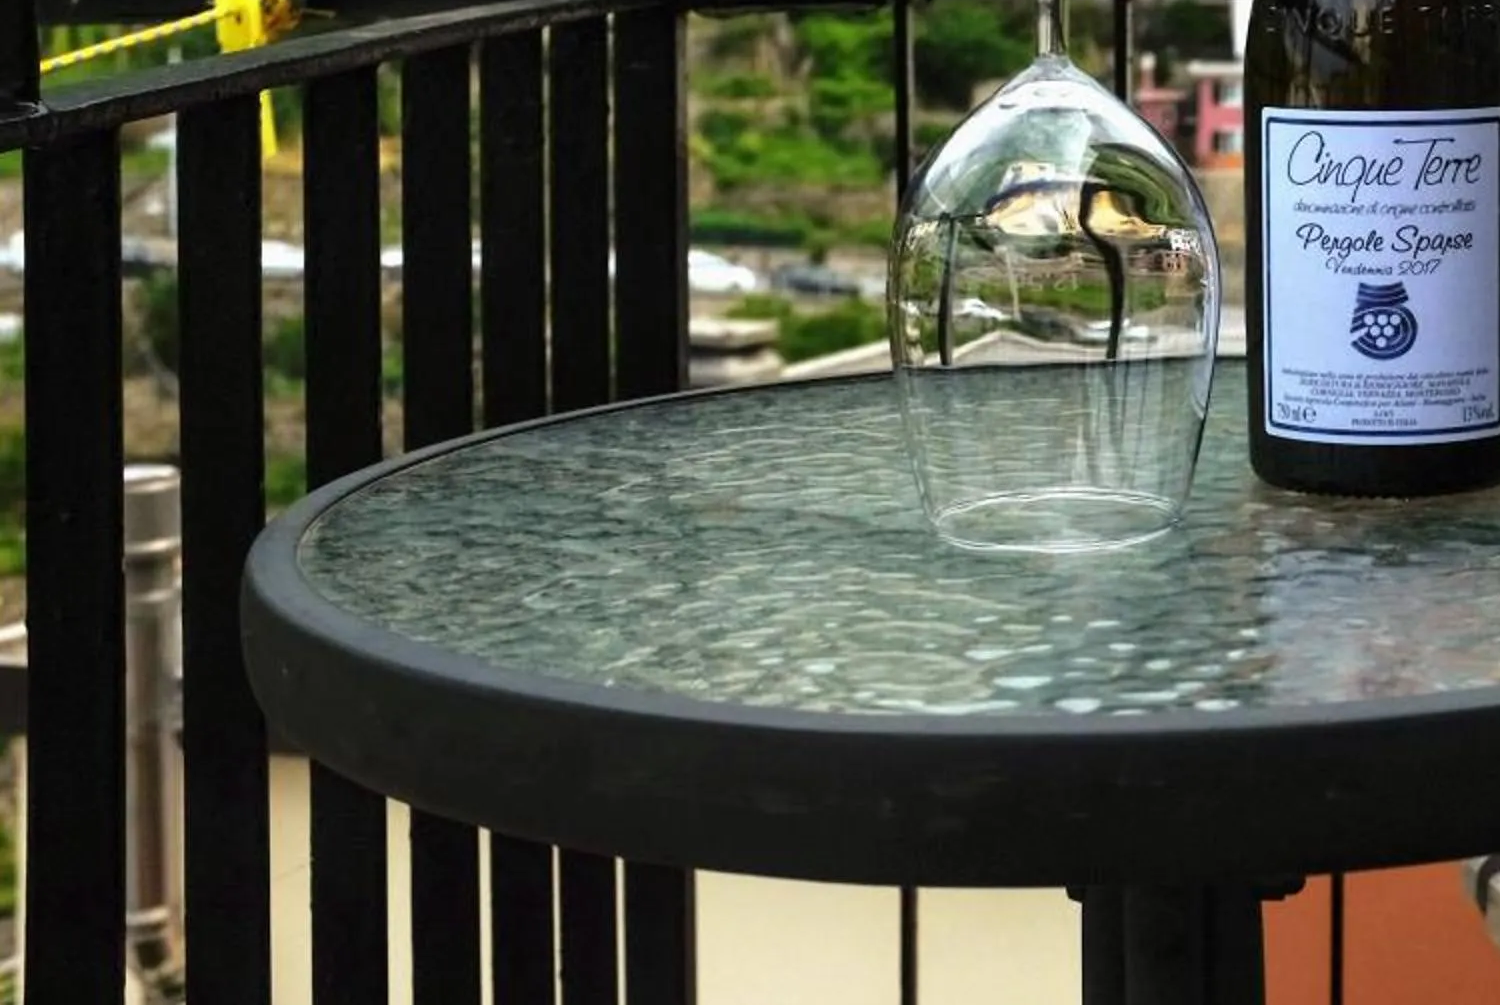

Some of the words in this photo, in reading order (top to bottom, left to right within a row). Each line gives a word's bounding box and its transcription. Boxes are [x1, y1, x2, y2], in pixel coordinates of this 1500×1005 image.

[1287, 130, 1404, 203] Cinque
[1393, 138, 1482, 190] Terre
[1296, 222, 1385, 259] Pergole
[1391, 224, 1473, 259] Sparse
[1398, 258, 1442, 276] 2017
